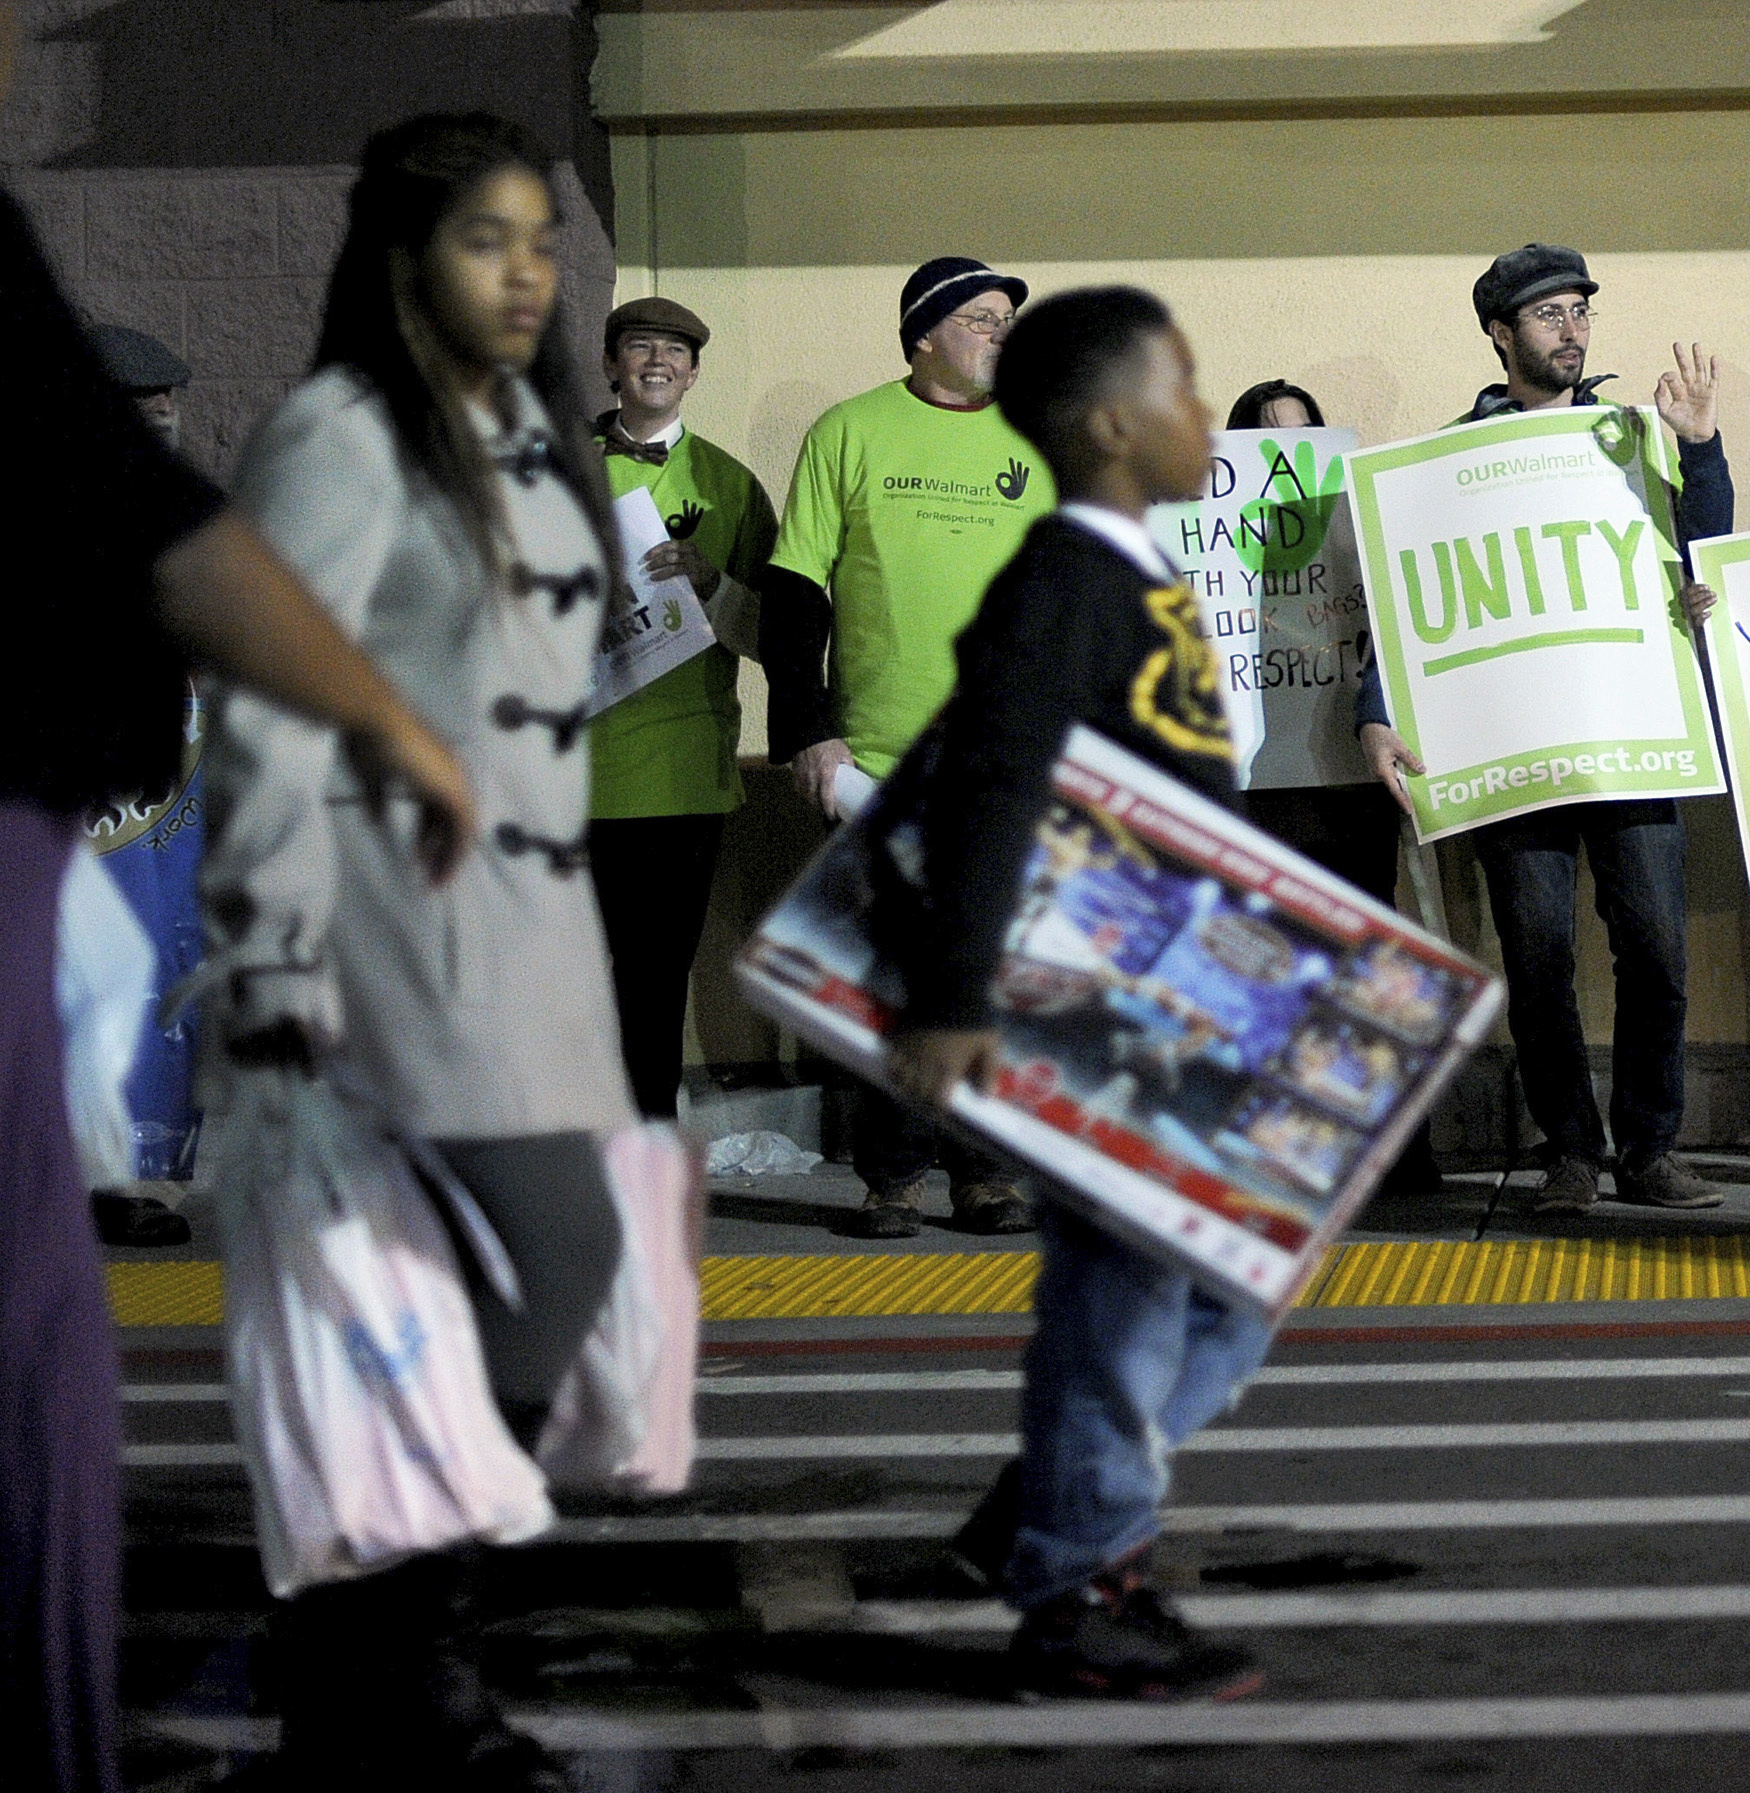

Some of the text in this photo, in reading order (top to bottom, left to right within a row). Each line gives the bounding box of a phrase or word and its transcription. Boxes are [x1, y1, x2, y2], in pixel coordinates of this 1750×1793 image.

[1260, 450, 1307, 500] A
[916, 510, 995, 526] ForRespect.org
[1181, 506, 1305, 555] HAND
[1240, 564, 1327, 597] YOUR
[1399, 519, 1646, 645] UNITY
[1207, 607, 1280, 639] OOK
[1230, 630, 1369, 692] RESPECT!
[1428, 747, 1698, 811] ForRespect.org
